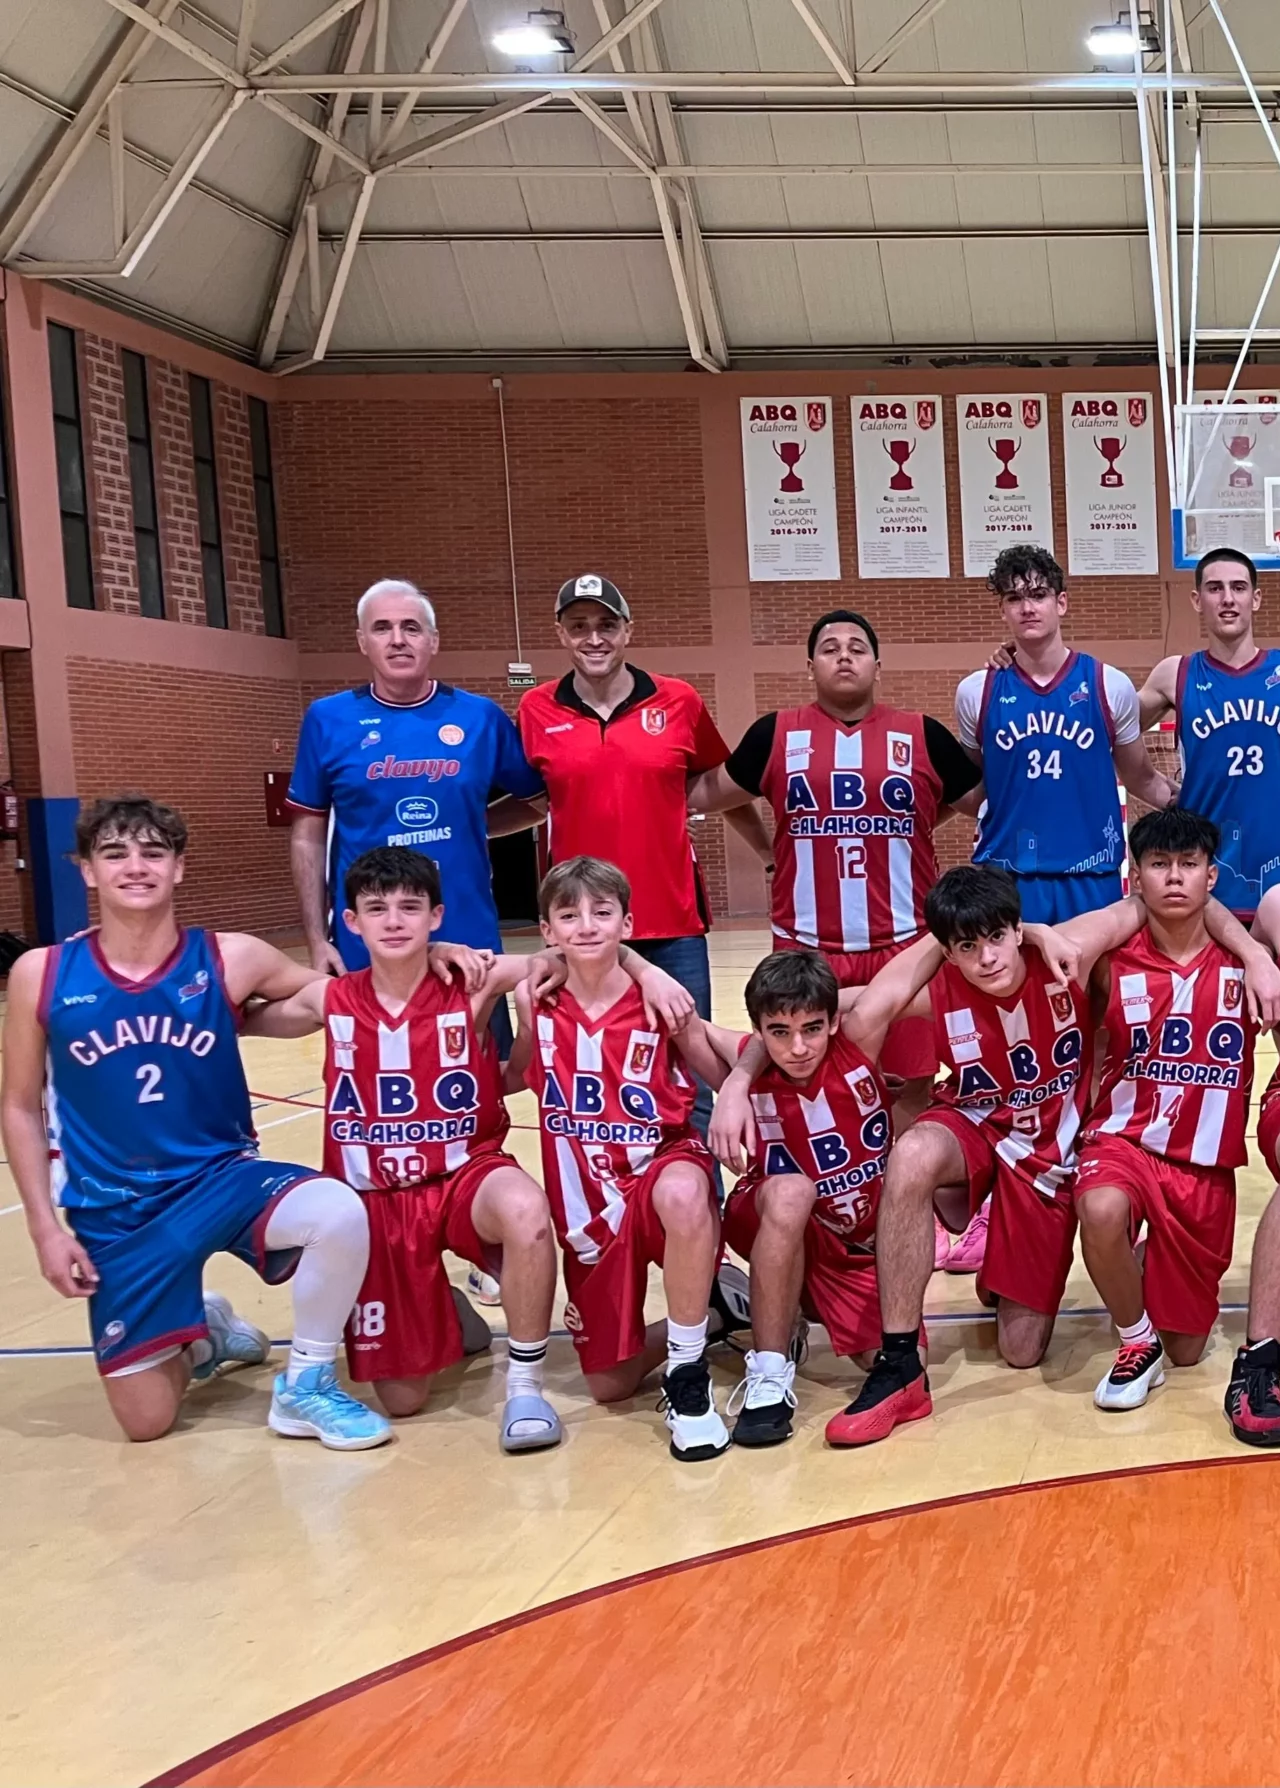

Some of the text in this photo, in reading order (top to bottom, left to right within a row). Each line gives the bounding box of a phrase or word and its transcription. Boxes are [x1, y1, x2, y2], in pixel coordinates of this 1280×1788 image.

[749, 405, 797, 421] ABQ
[859, 403, 907, 419] ABQ
[965, 401, 1013, 418] ABQ
[1071, 400, 1119, 416] ABQ
[750, 422, 798, 433] Calahorra
[860, 421, 907, 432] Calahorra
[966, 418, 1013, 430] Calahorra
[1072, 417, 1119, 428] Calahorra
[774, 517, 813, 526] CAMPEÓN
[883, 515, 923, 524] CAMPEÓN
[988, 514, 1028, 522] CAMPEÓN
[1094, 512, 1132, 520] CAMPEÓN
[996, 710, 1094, 750] CLAVIJO
[1027, 750, 1062, 780] 34
[1227, 746, 1264, 776] 23
[402, 811, 432, 820] Reina
[788, 816, 914, 836] CALAHORRA
[388, 827, 451, 846] PROTEINAS
[835, 846, 867, 880] 12
[69, 1016, 216, 1066] CLAVIJO
[136, 1064, 164, 1104] 2
[1151, 1091, 1184, 1128] 14
